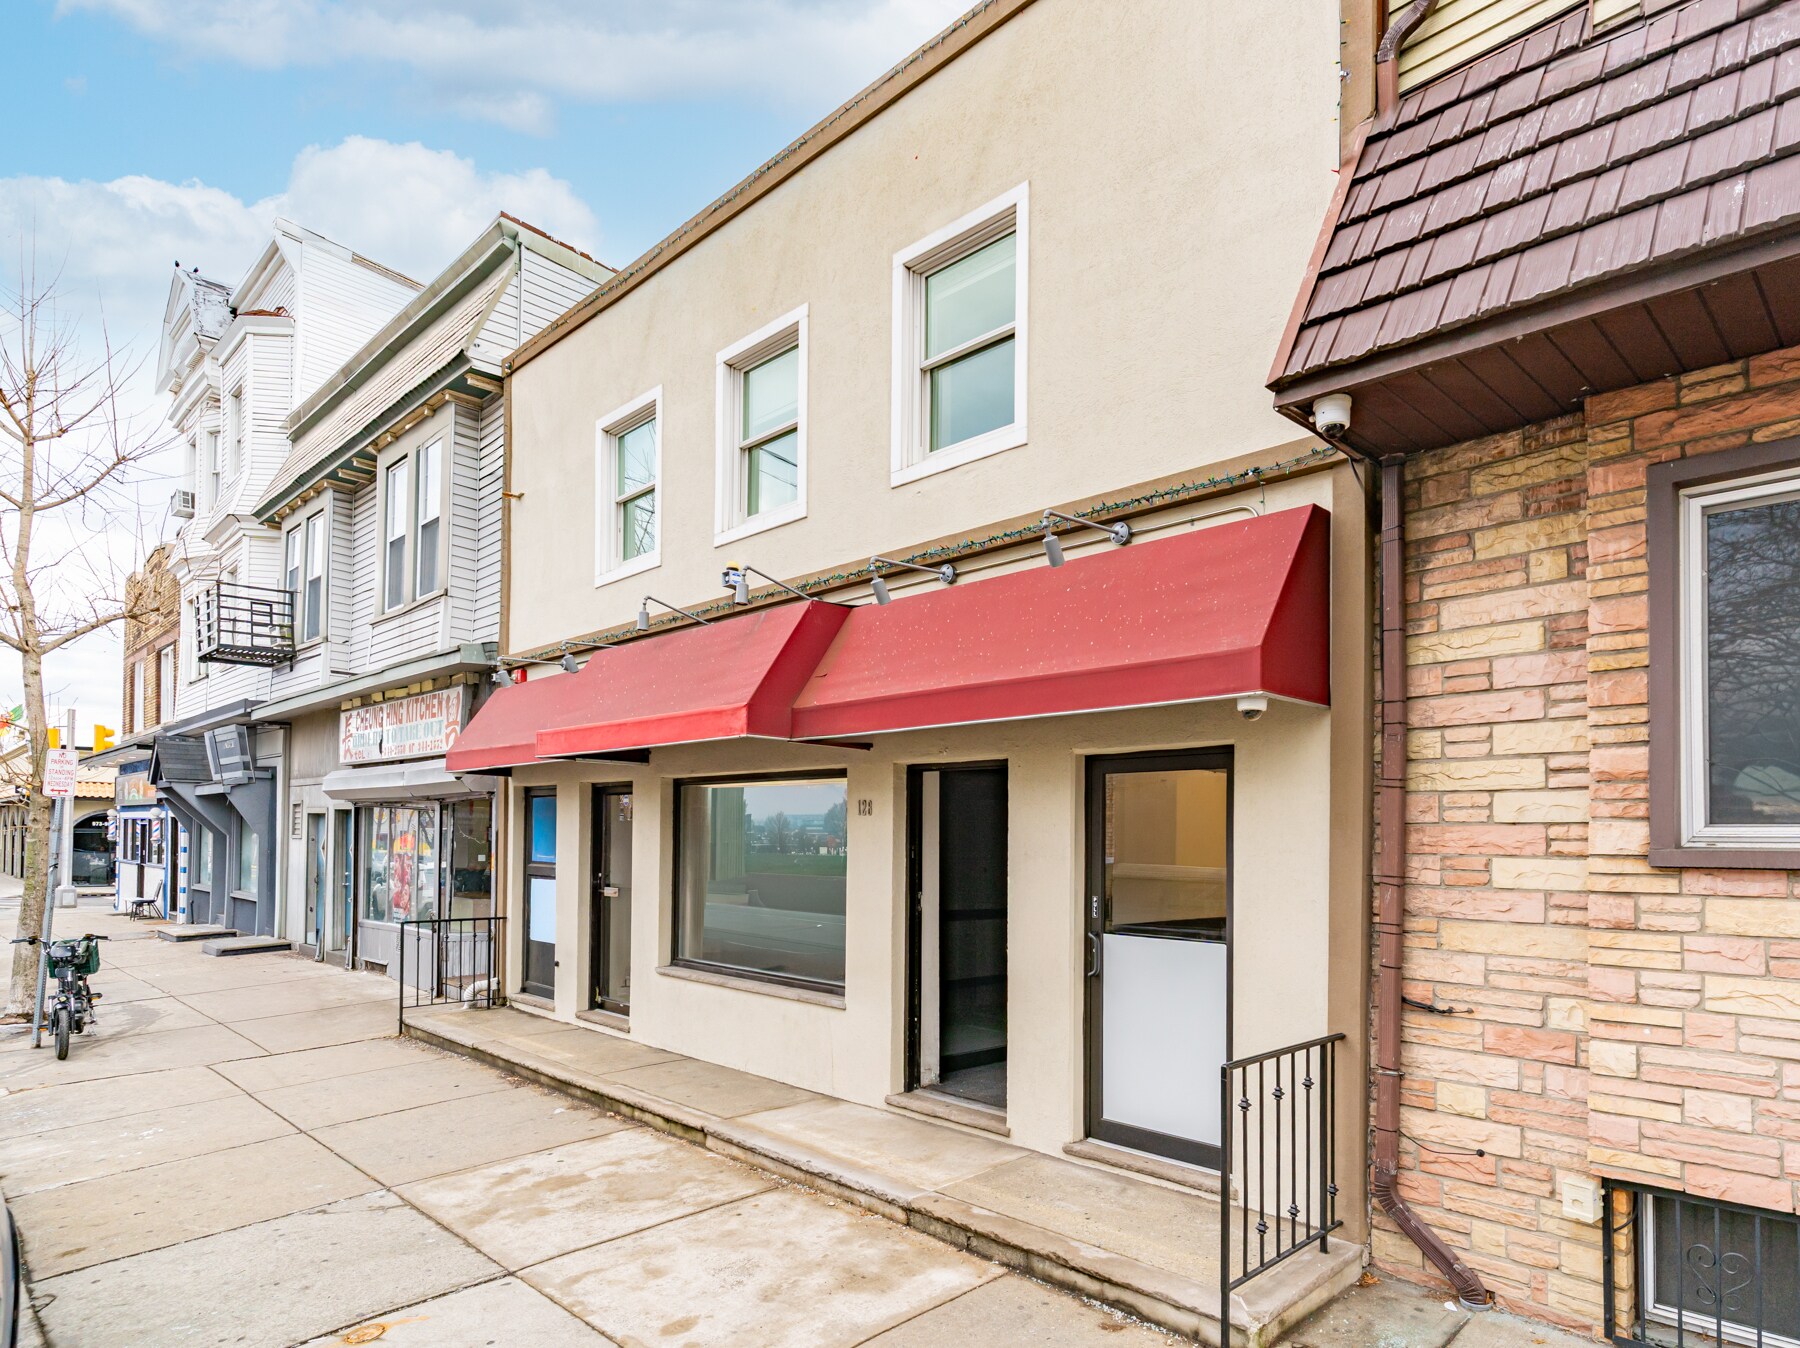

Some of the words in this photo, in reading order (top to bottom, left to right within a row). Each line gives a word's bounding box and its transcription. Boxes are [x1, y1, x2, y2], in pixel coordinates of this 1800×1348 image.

[355, 706, 384, 732] CHEUNG
[386, 701, 403, 726] HING
[405, 692, 444, 723] KITCHEN
[423, 719, 444, 739] OUT
